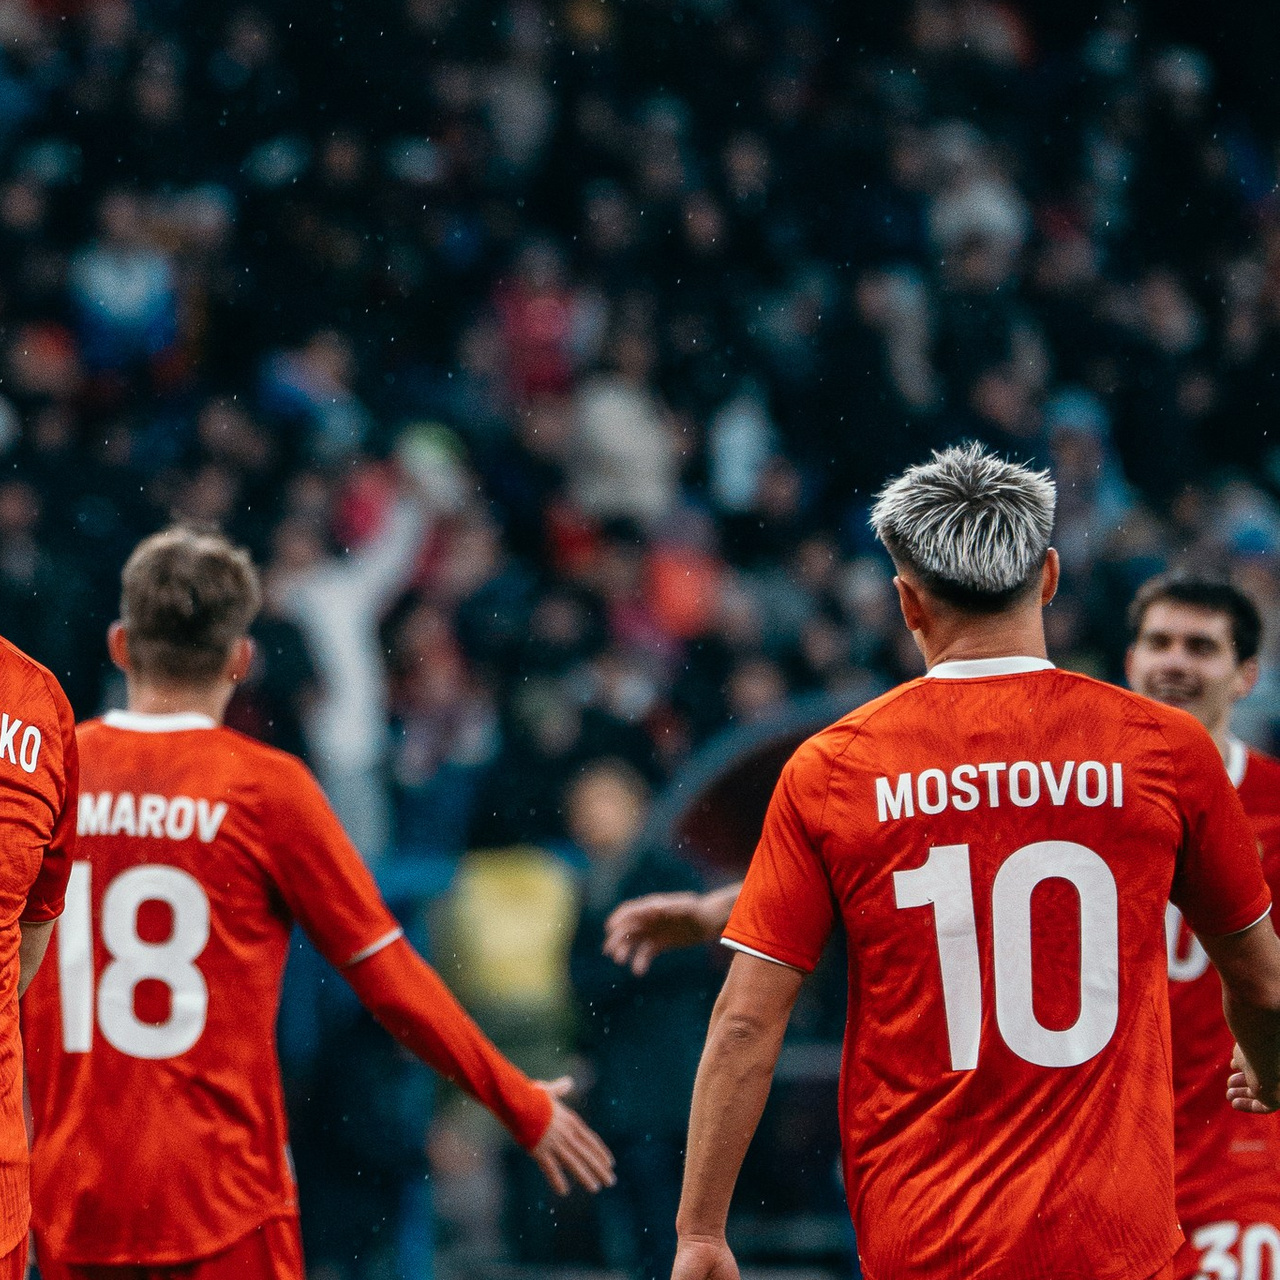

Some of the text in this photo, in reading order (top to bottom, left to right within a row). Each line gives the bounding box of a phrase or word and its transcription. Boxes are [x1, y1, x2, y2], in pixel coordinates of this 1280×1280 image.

[875, 760, 1124, 823] MOSTOVOI
[57, 859, 211, 1060] 18
[892, 839, 1120, 1071] 10
